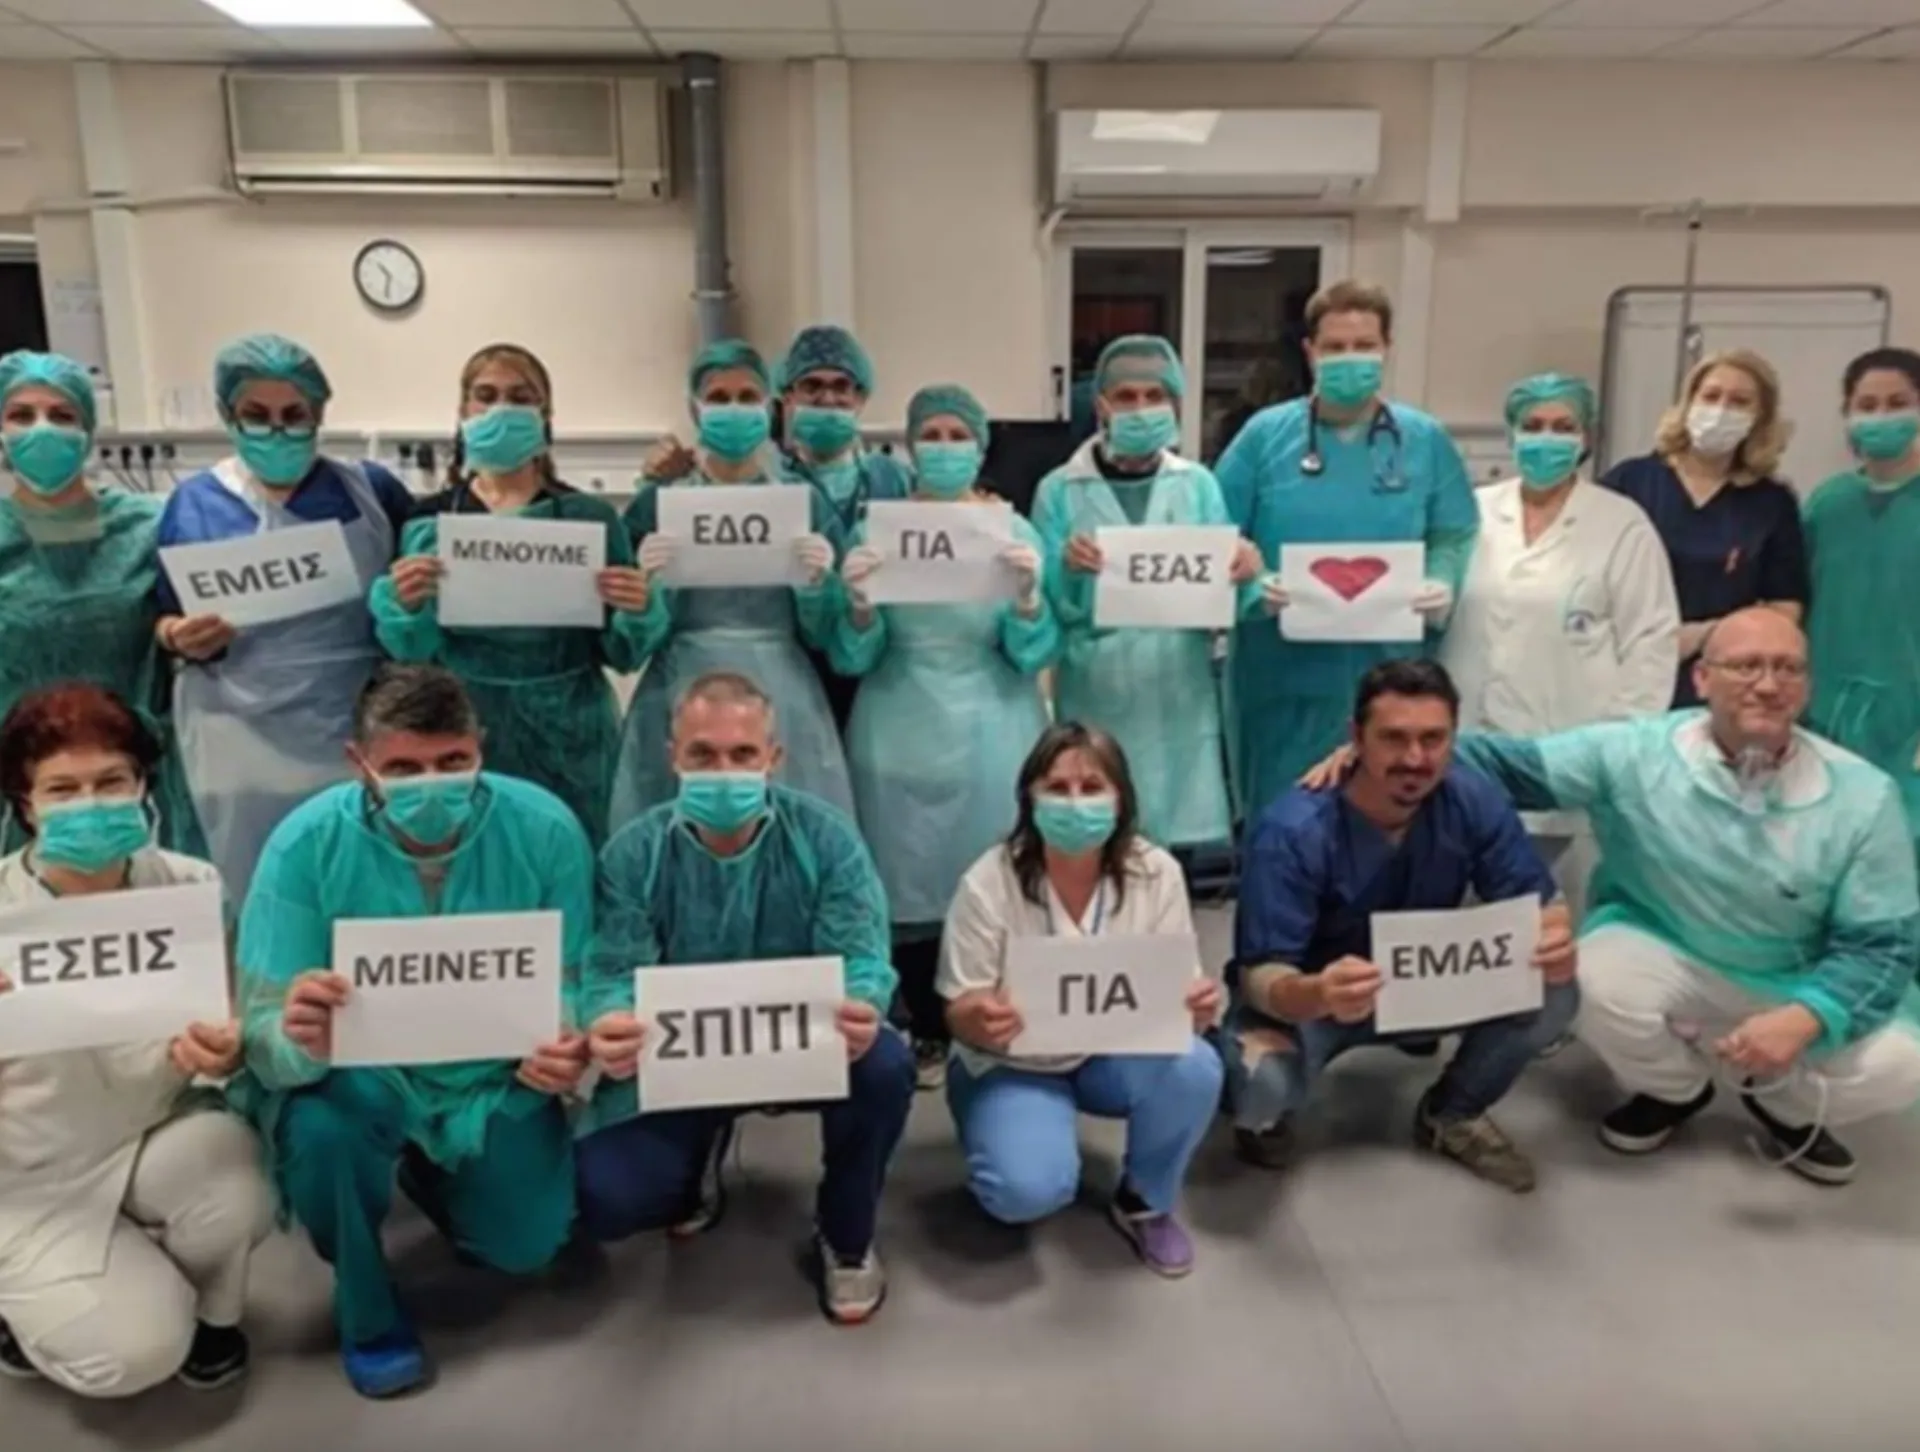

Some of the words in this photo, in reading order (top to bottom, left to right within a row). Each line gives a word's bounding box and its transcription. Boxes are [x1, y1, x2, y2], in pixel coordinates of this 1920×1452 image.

[692, 513, 771, 546] ΕΔΩ
[899, 529, 955, 562] ΓΙΑ
[451, 538, 590, 568] ΜΕΝΟΥΜΕ
[1127, 553, 1212, 585] ΕΣΑΣ
[187, 551, 330, 600] ΕΜΕΙΣ
[20, 927, 177, 986] ΕΣΕΙΣ
[353, 946, 536, 989] ΜΕΙΝΕΤΕ
[1391, 933, 1514, 980] ΕΜΑΣ
[1058, 972, 1139, 1016] ΓΙΑ
[656, 1002, 811, 1060] ΣΠΙΤΙ
